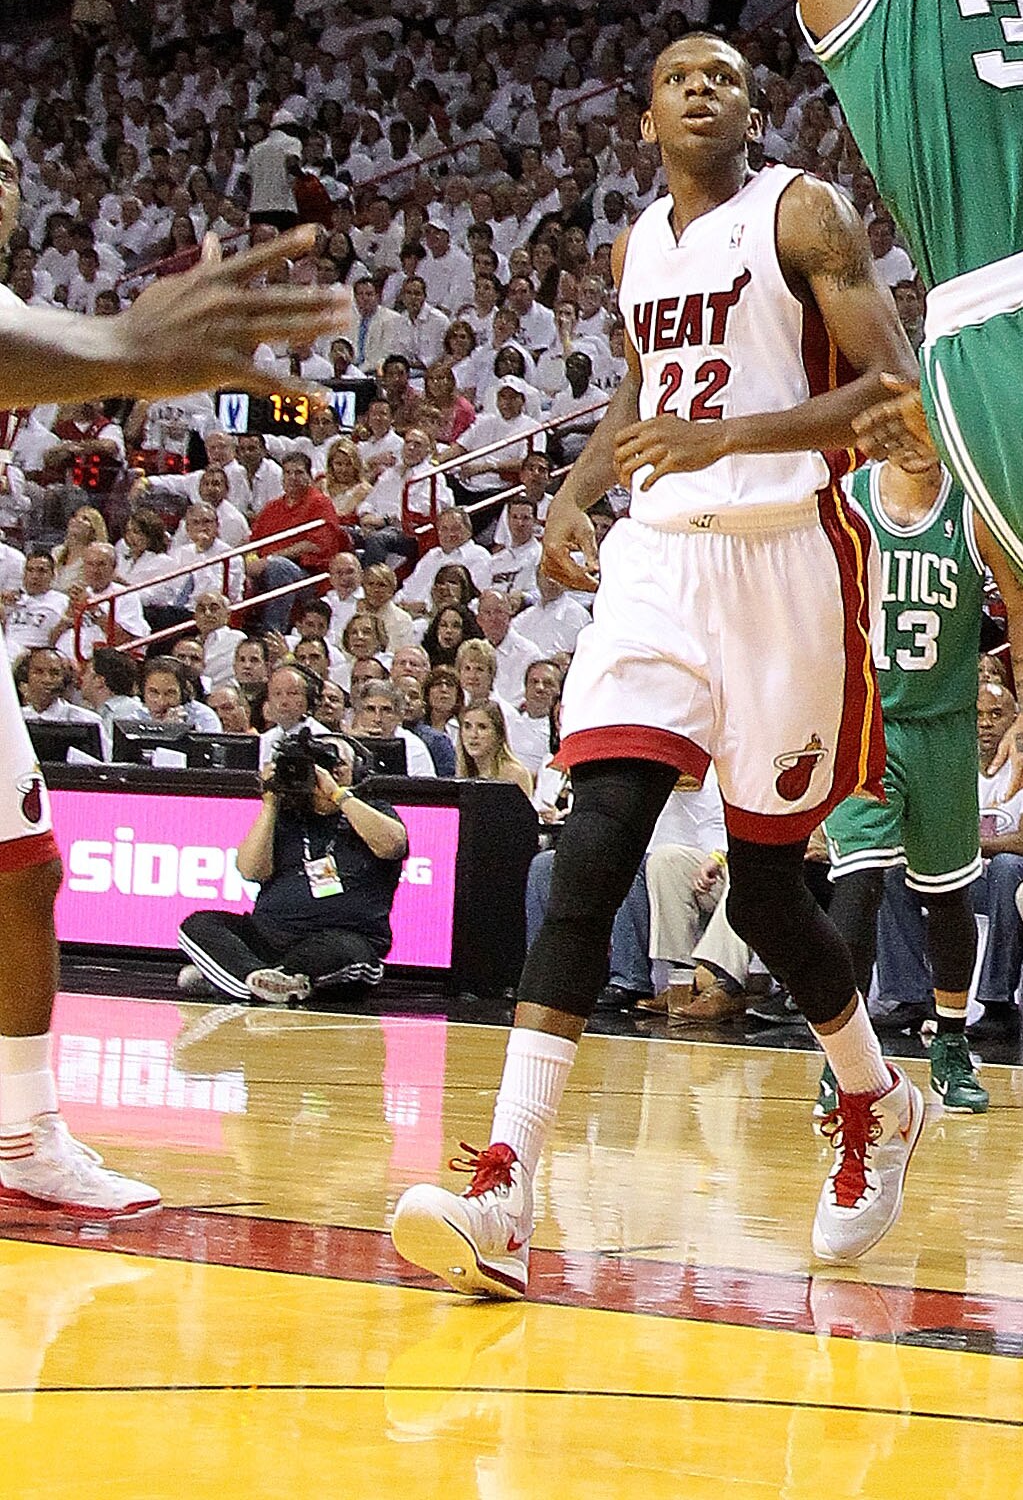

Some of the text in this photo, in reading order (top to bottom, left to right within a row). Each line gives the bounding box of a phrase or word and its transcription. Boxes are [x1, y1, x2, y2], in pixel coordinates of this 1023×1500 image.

[633, 267, 752, 355] HEAT
[656, 358, 732, 421] 22
[881, 550, 959, 610] LTICS
[872, 609, 941, 671] 13
